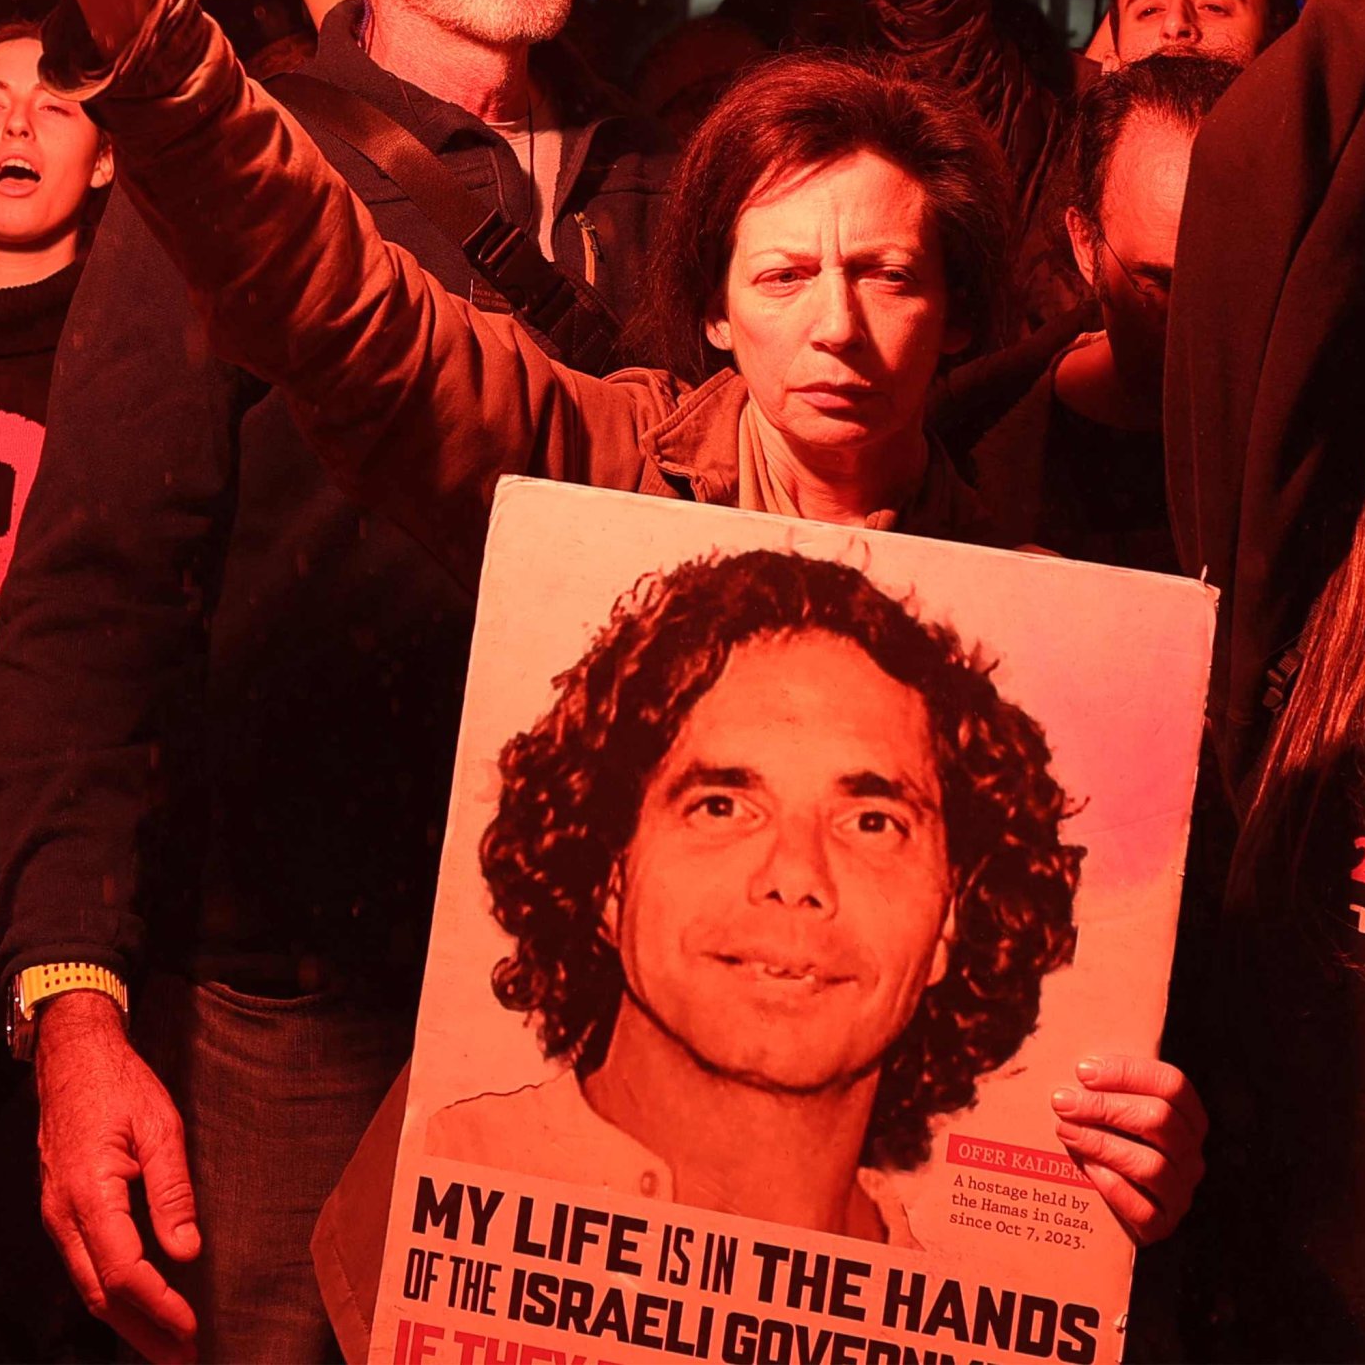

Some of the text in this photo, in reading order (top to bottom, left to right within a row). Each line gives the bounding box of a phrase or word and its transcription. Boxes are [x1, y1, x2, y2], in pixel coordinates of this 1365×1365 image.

[957, 1142, 1007, 1167] OFER
[951, 1192, 1094, 1235] the Hamas in Gaza,
[953, 1173, 1090, 1215] A hostage held by
[949, 1211, 1086, 1251] since Oct 7, 2023.
[411, 1175, 1101, 1365] MY LIFE IS IN THE HANDS
[402, 1247, 445, 1303] OF
[447, 1255, 503, 1317] THE
[507, 1268, 715, 1360] ISRAELI
[390, 1319, 446, 1365] IF
